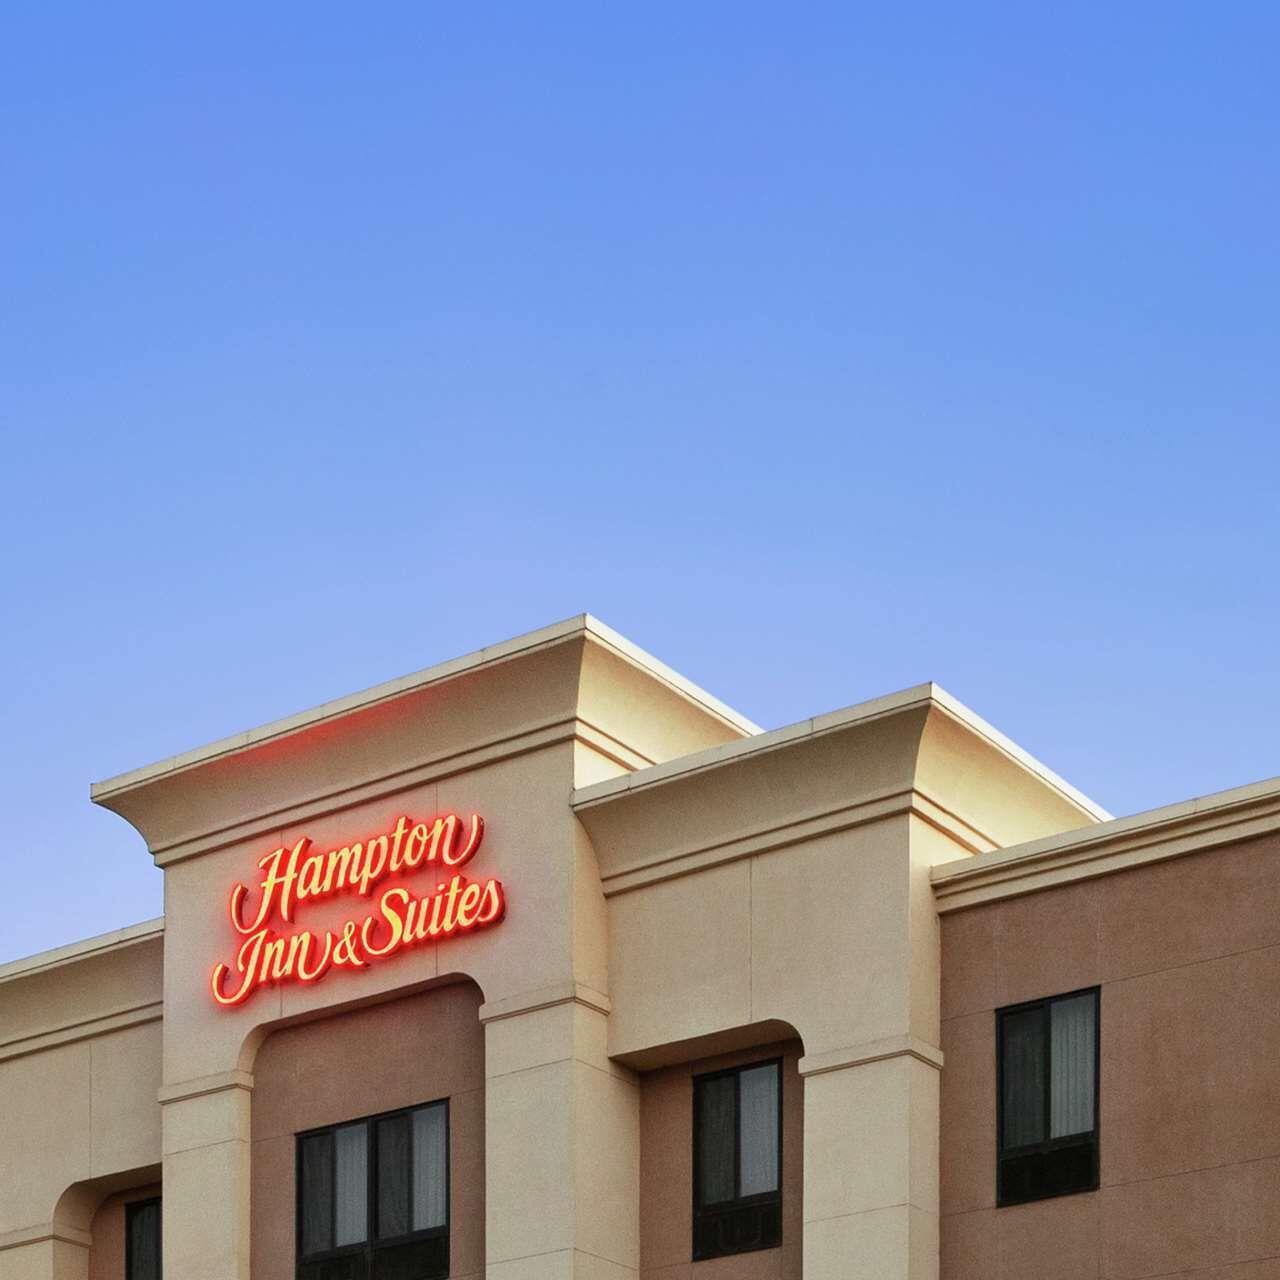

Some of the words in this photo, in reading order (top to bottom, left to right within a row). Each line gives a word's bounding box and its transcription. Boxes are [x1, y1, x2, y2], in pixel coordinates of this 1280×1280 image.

[230, 814, 485, 934] Hampton
[211, 929, 333, 1005] Inn
[332, 920, 368, 967] &
[361, 873, 506, 956] Suites
